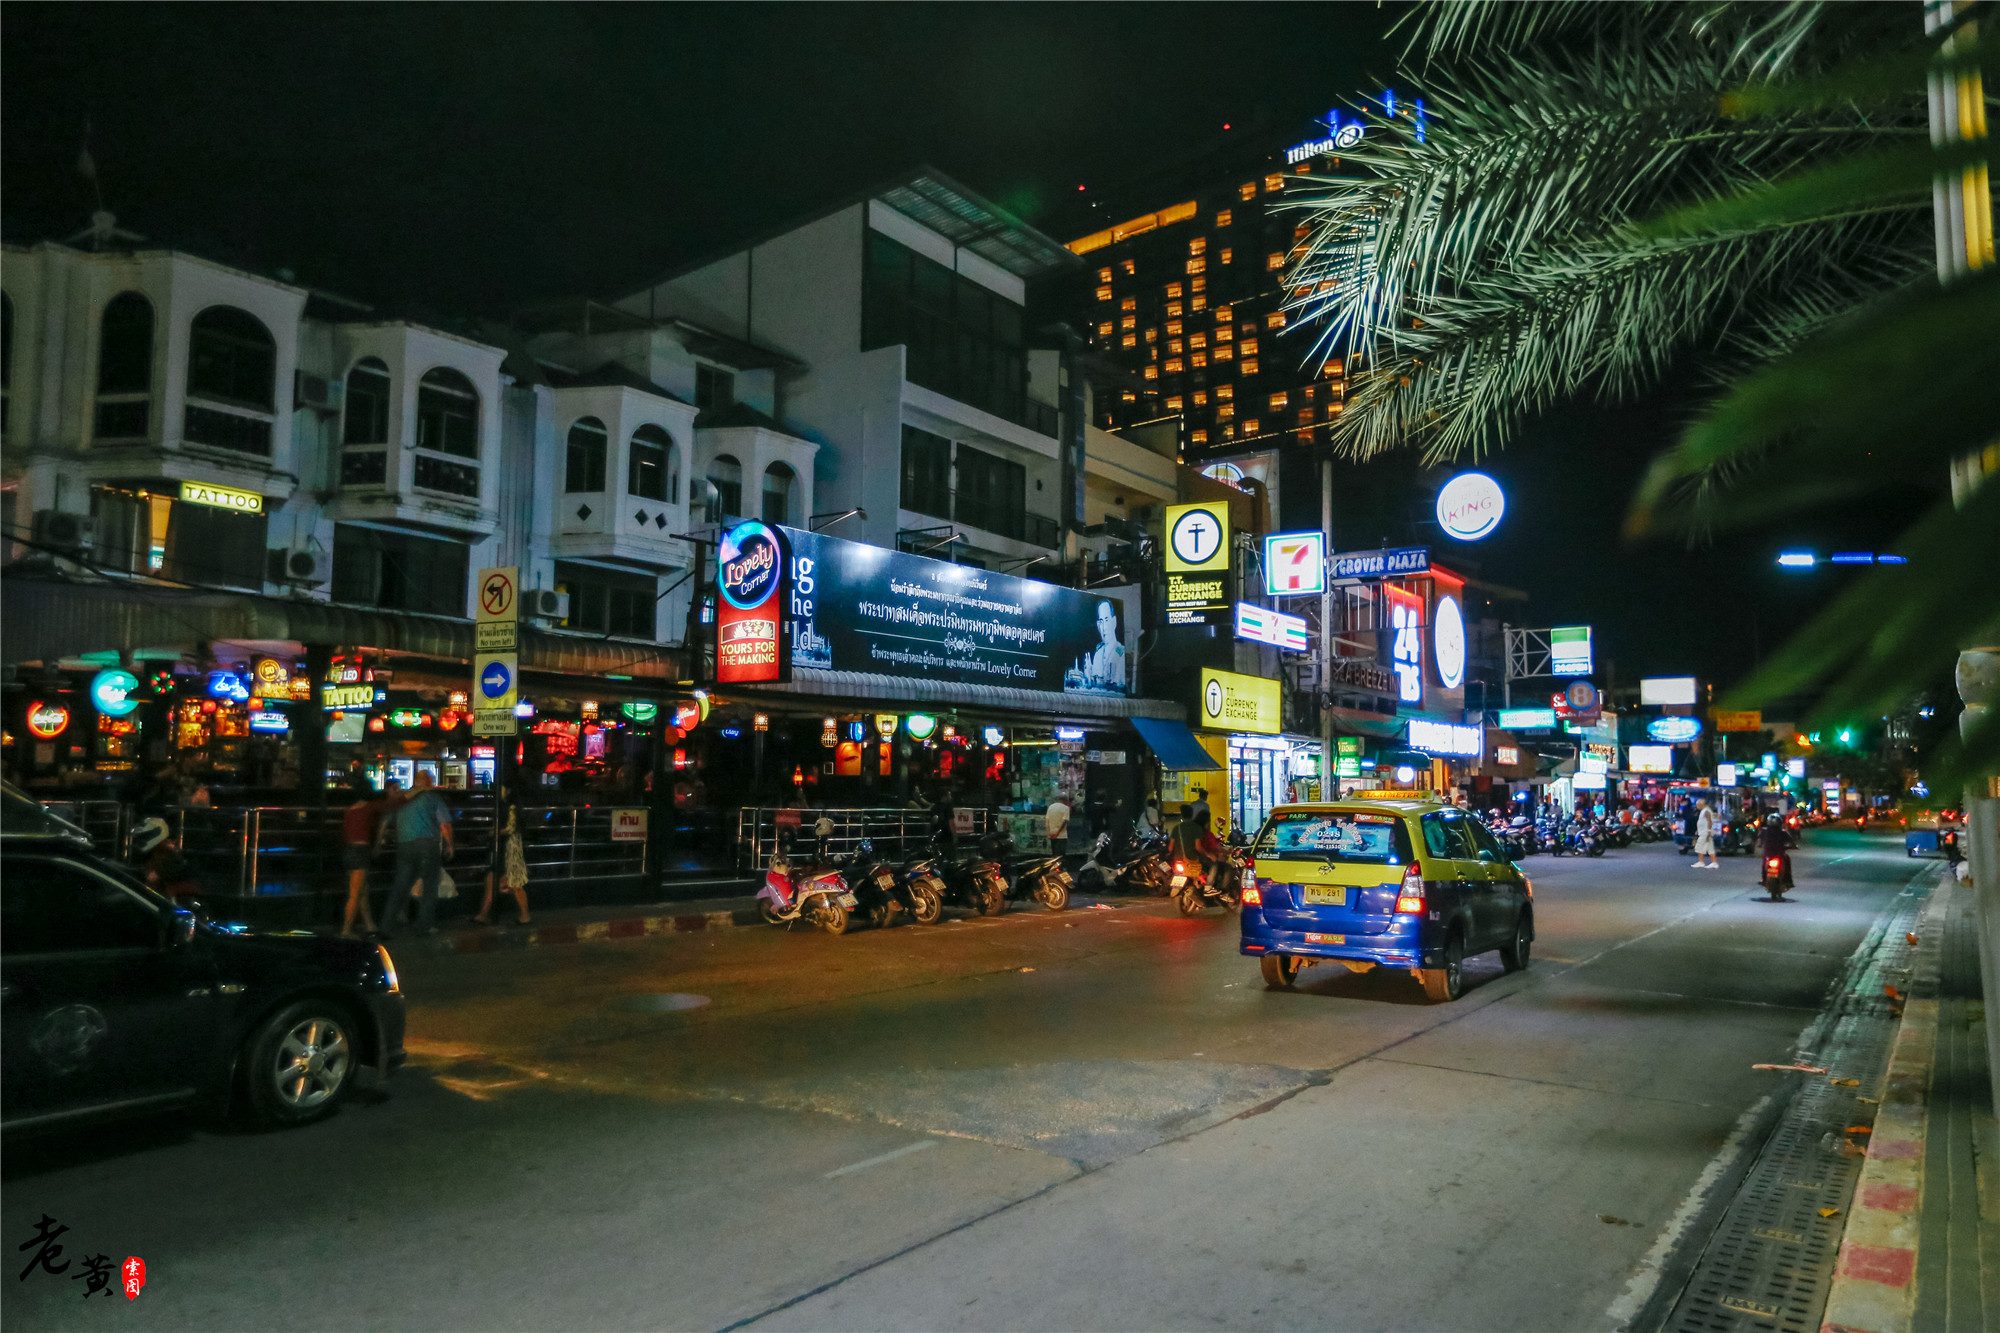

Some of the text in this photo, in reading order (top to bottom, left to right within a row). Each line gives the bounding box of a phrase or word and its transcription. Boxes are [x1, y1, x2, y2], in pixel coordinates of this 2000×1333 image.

[1287, 139, 1334, 165] Hilton
[185, 486, 260, 509] TATTOO
[1448, 496, 1493, 523] KING
[725, 542, 774, 588] Lovely
[1280, 544, 1309, 590] 7
[1387, 553, 1427, 571] PLAZA
[1168, 576, 1184, 585] T.T.
[1168, 582, 1222, 593] CURRENCY
[1168, 590, 1223, 601] EXCHANGE
[1168, 611, 1194, 619] MONEY
[1168, 616, 1205, 624] EXCHANGE
[721, 641, 775, 655] YOURS FOR
[721, 653, 775, 666] THE MAKING
[343, 670, 358, 681] LEO
[987, 661, 1012, 678] Lovely
[1013, 664, 1037, 678] Corner
[1354, 667, 1388, 690] BREEZE
[323, 686, 374, 706] TATTOO
[1226, 697, 1258, 710] CURRENCY
[1226, 708, 1258, 721] EXCHANGE
[483, 723, 507, 732] One way
